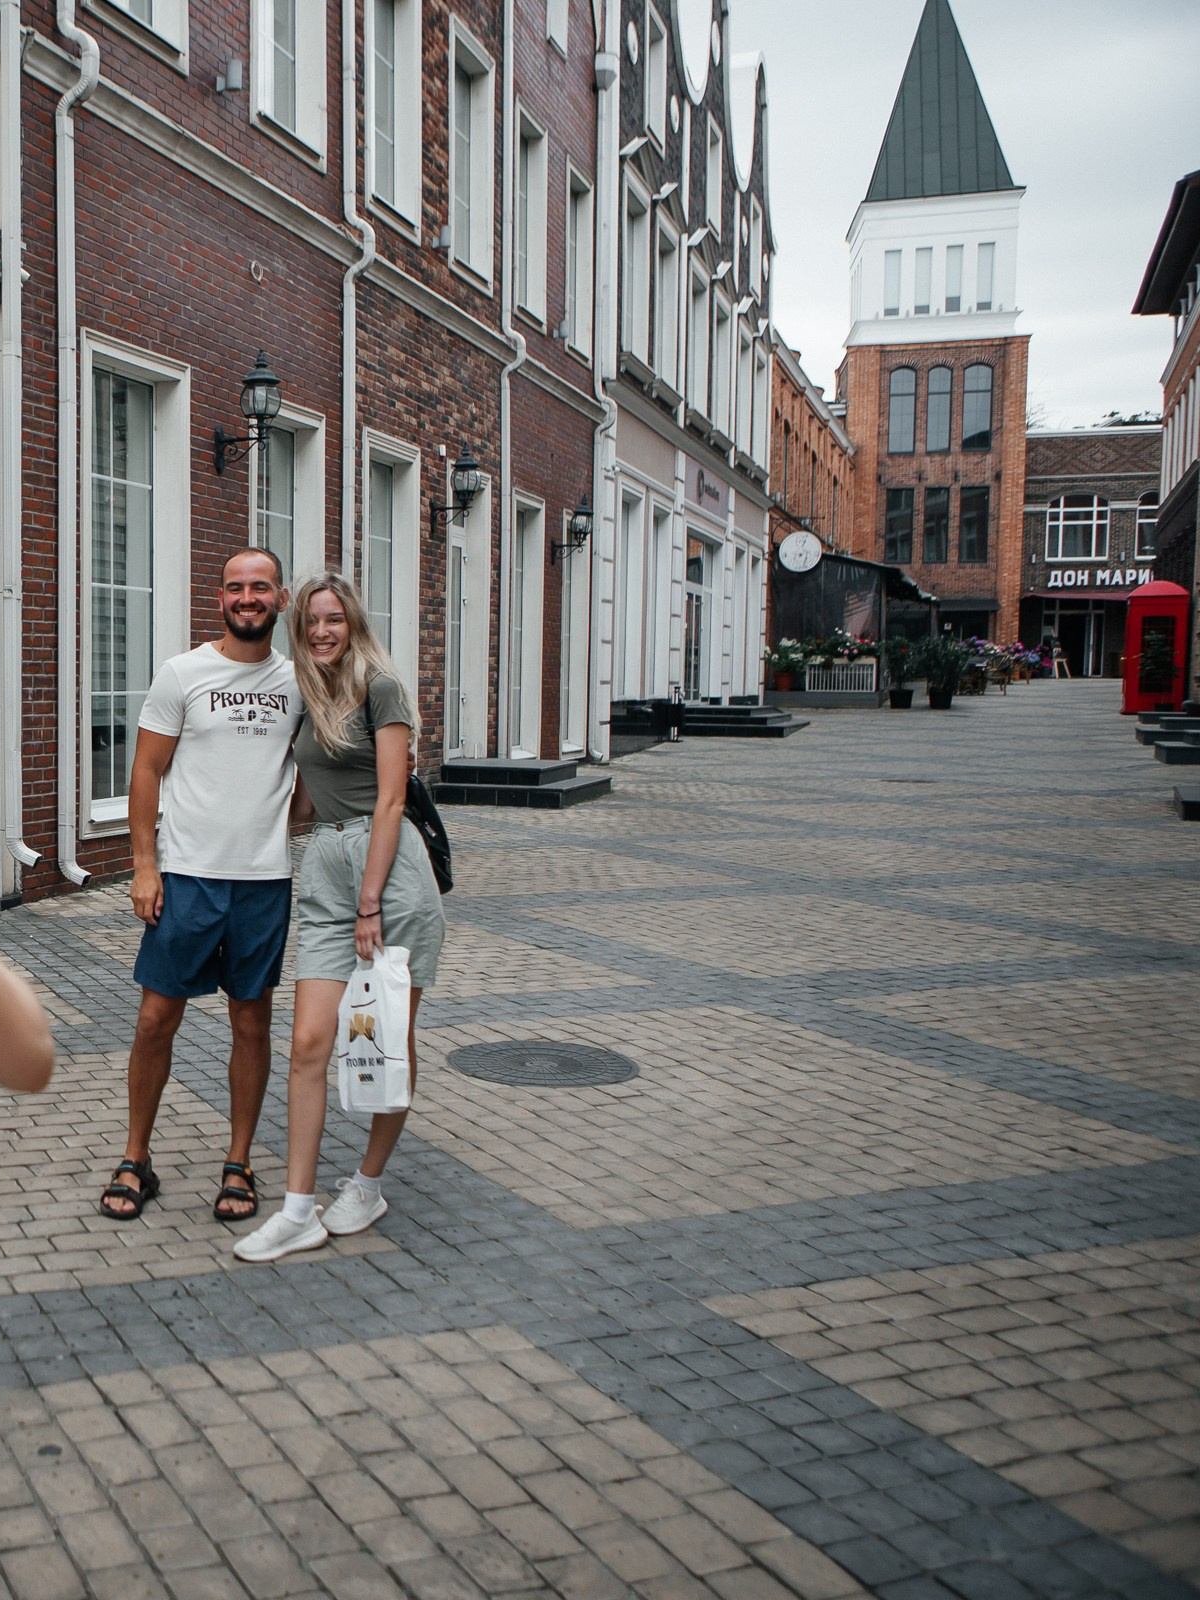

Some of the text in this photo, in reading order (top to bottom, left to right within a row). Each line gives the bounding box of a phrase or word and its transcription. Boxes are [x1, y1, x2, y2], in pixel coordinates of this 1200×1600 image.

[1047, 570, 1089, 588] ДОН
[210, 691, 289, 715] PROTEST
[237, 726, 268, 736] EST 1993
